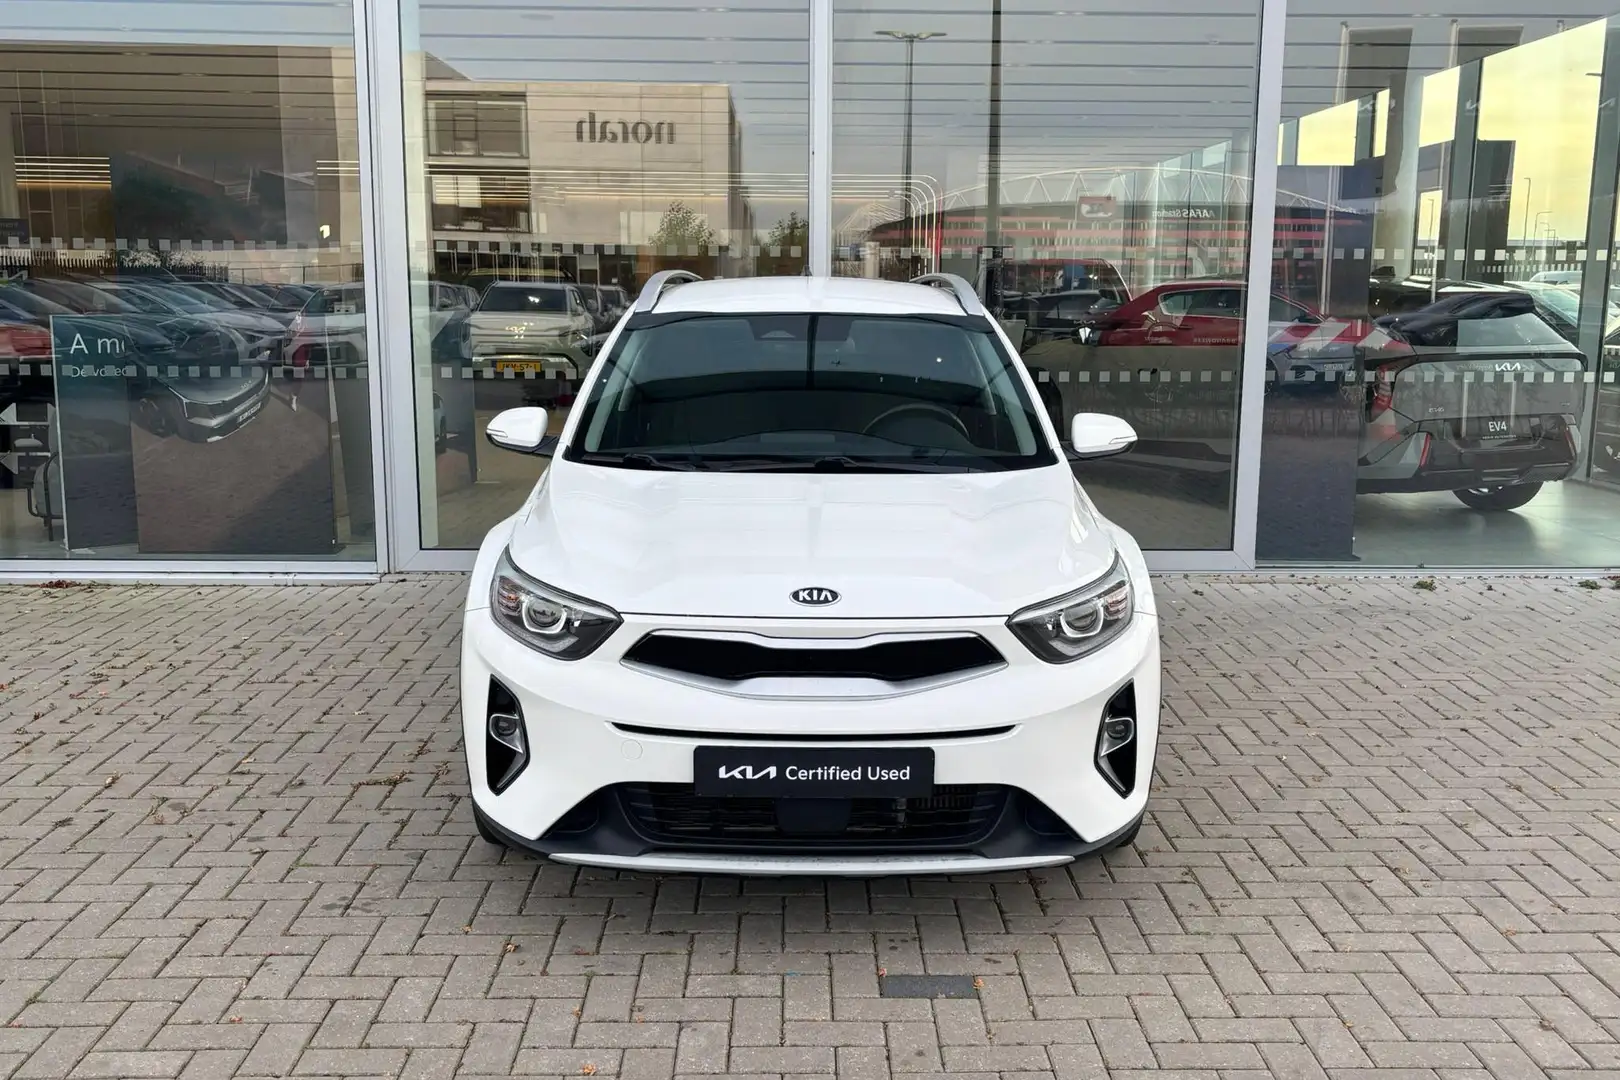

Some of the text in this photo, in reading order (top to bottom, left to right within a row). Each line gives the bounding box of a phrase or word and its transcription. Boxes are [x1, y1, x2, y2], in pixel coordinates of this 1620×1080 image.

[70, 333, 88, 354] A
[1488, 421, 1507, 432] EV4
[798, 589, 832, 601] KIA
[718, 765, 911, 781] KIA Certified Used
